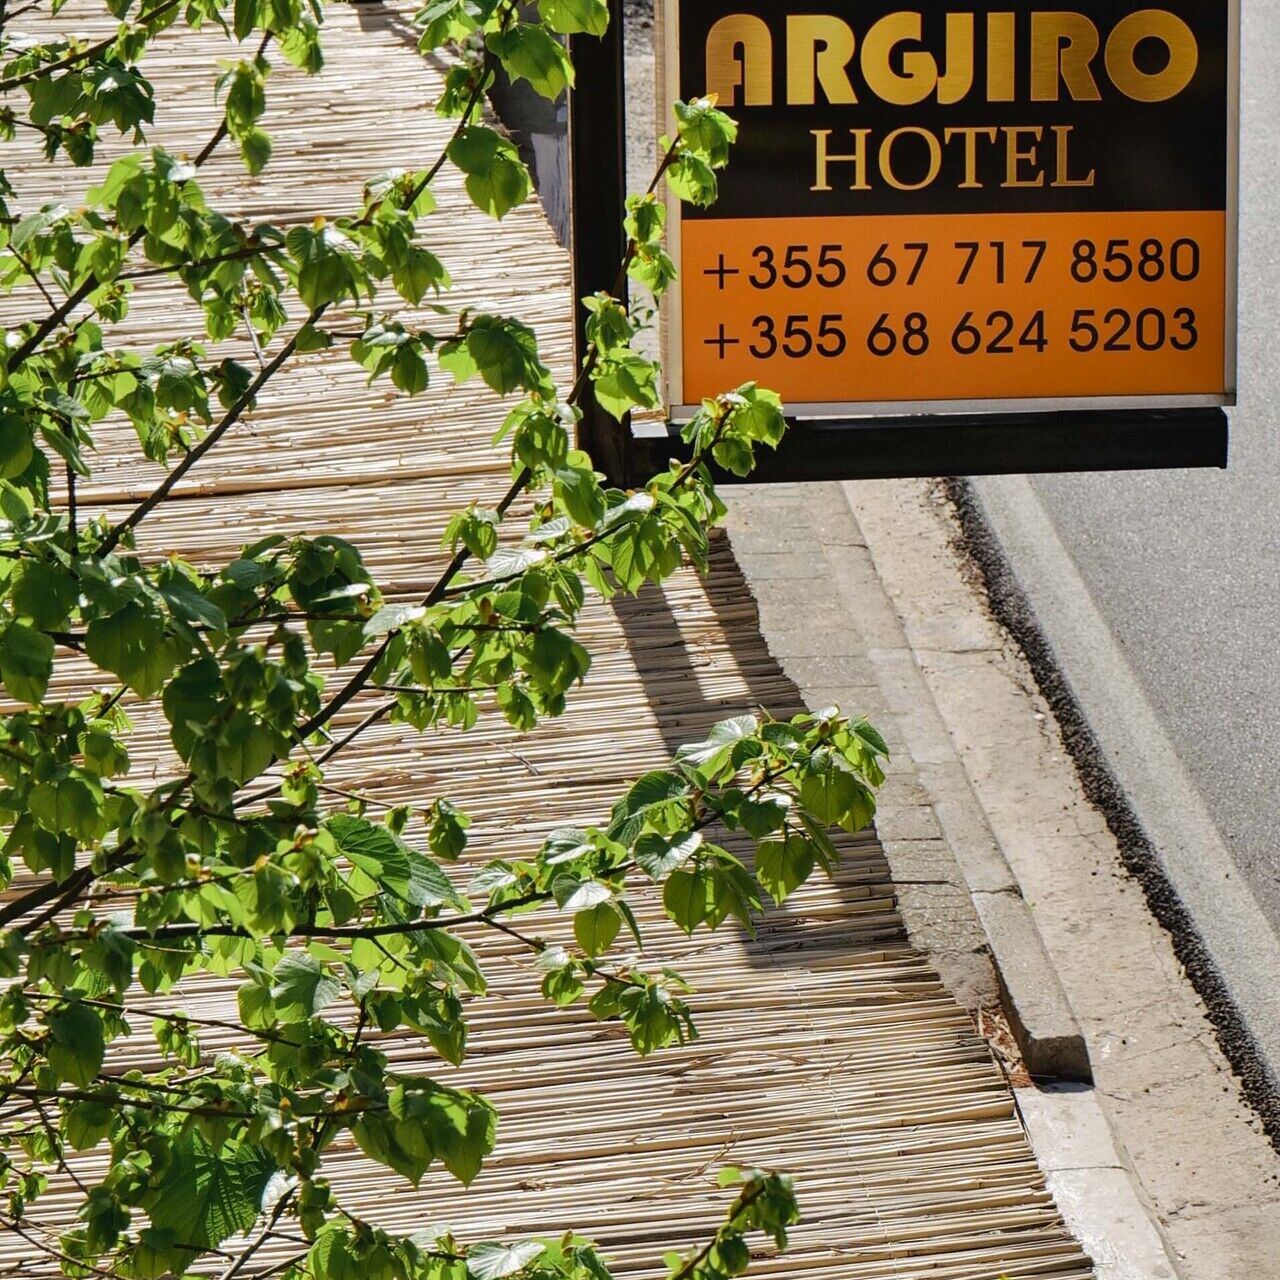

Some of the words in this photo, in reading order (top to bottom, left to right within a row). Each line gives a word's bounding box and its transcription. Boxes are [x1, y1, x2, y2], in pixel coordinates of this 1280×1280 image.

[705, 8, 1199, 107] ARGJIRO
[809, 125, 1096, 192] HOTEL
[703, 243, 847, 290] +355
[866, 242, 930, 288] 67
[953, 240, 1048, 285] 717
[1069, 237, 1201, 284] 8580
[703, 313, 847, 360] +355
[866, 311, 930, 356] 68
[950, 309, 1049, 355] 624
[1067, 306, 1200, 352] 5203
